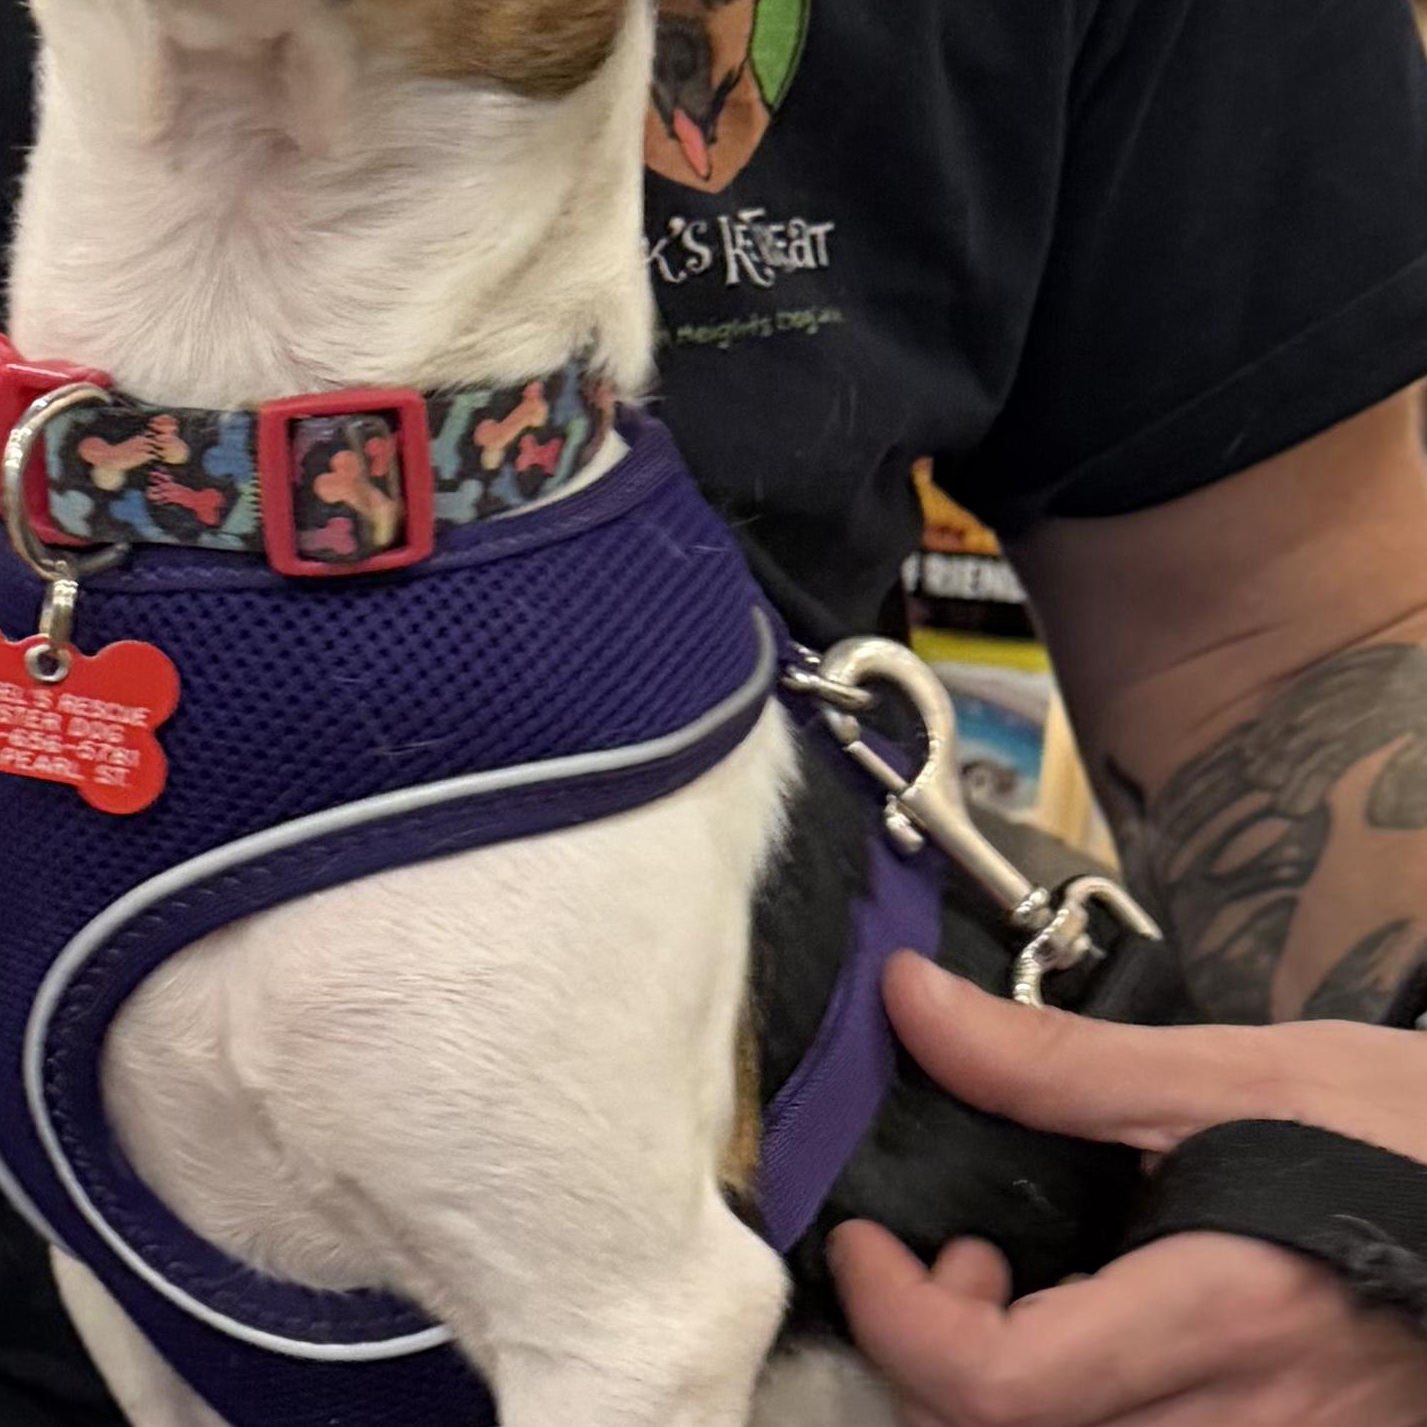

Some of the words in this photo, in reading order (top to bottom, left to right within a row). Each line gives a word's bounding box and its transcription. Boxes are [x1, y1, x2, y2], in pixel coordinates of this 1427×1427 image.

[58, 693, 151, 728] RESCUE
[67, 717, 125, 744] DOG
[94, 763, 133, 787] ST
